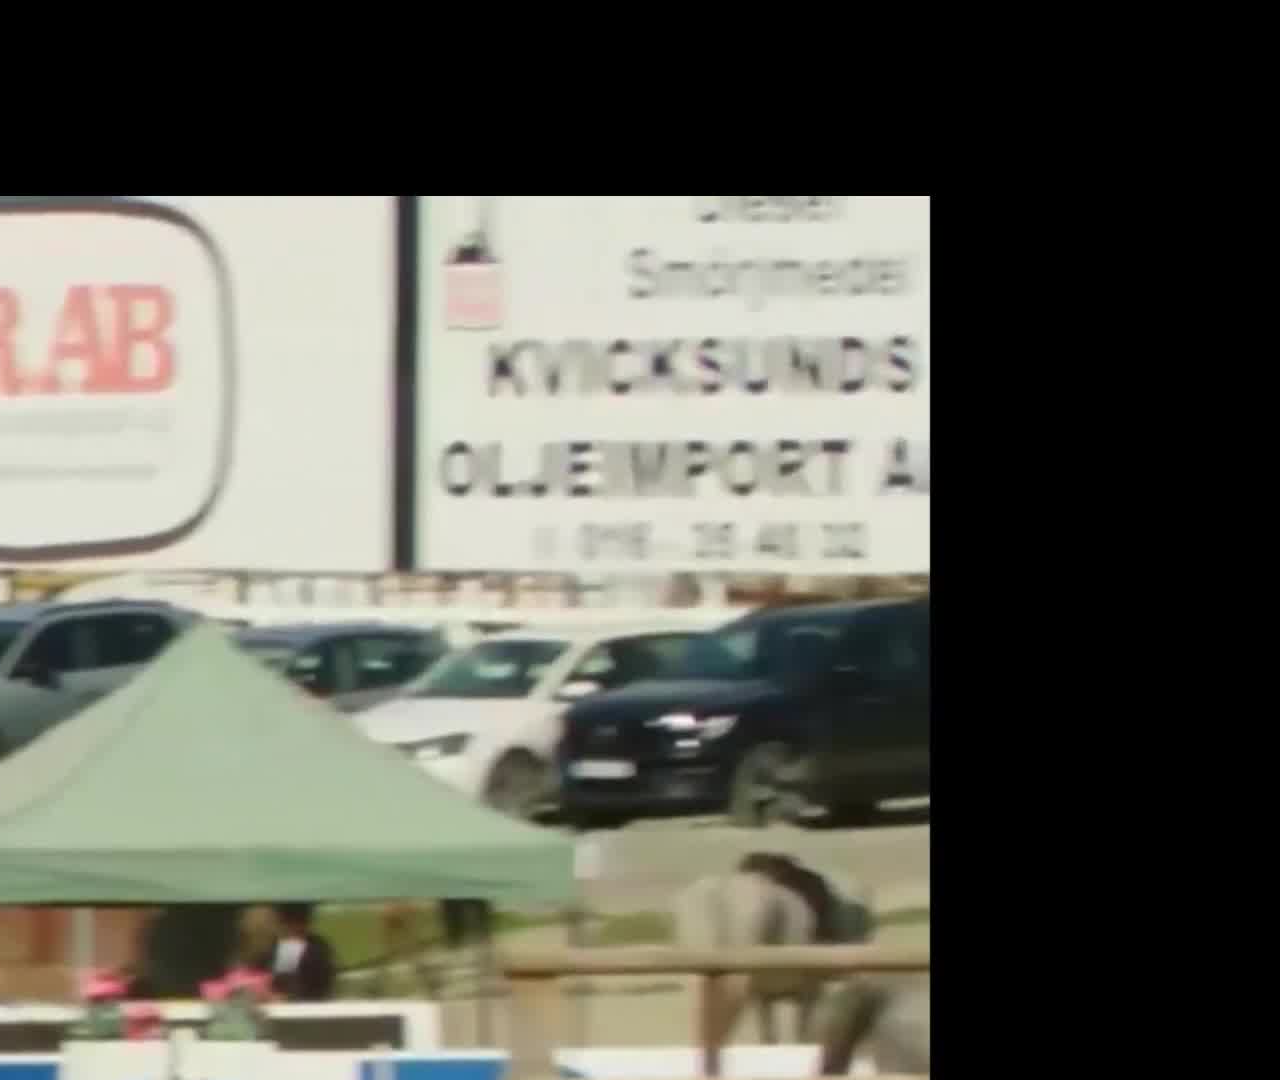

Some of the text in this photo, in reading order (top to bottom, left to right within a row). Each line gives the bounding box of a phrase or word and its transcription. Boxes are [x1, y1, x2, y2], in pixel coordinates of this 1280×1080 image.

[488, 335, 919, 396] KVICKSUNDS
[442, 437, 929, 498] OLJEIMPORT A
